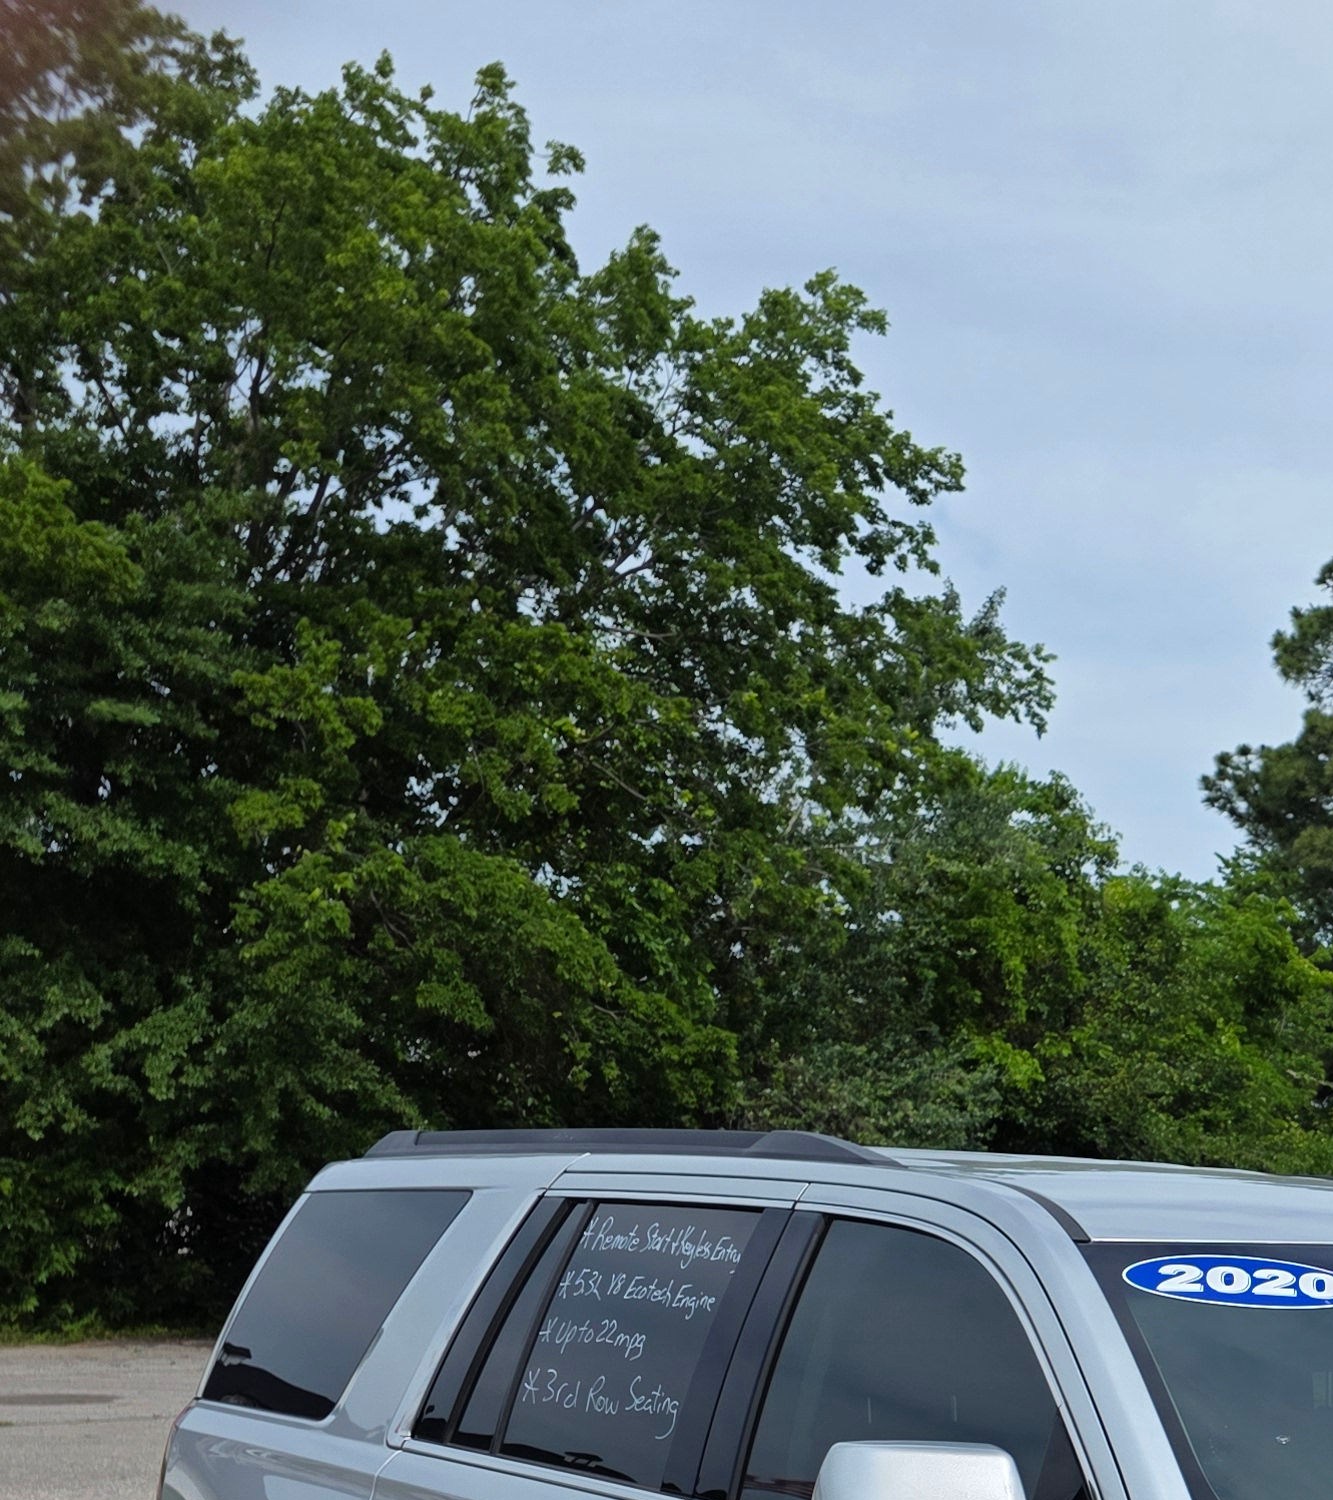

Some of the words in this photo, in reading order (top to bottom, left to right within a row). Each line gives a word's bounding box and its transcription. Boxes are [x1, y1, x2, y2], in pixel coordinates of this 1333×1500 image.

[592, 1216, 640, 1251] Remote
[640, 1223, 673, 1253] Start
[677, 1225, 712, 1269] Keyless
[711, 1237, 741, 1274] Entry
[607, 1272, 627, 1295] V8
[624, 1276, 674, 1308] Ecotech
[672, 1285, 715, 1319] Engine
[555, 1320, 577, 1354] Up
[578, 1320, 594, 1343] to
[542, 1369, 581, 1408] 3rd
[585, 1376, 620, 1415] Row
[625, 1376, 679, 1439] Seating
